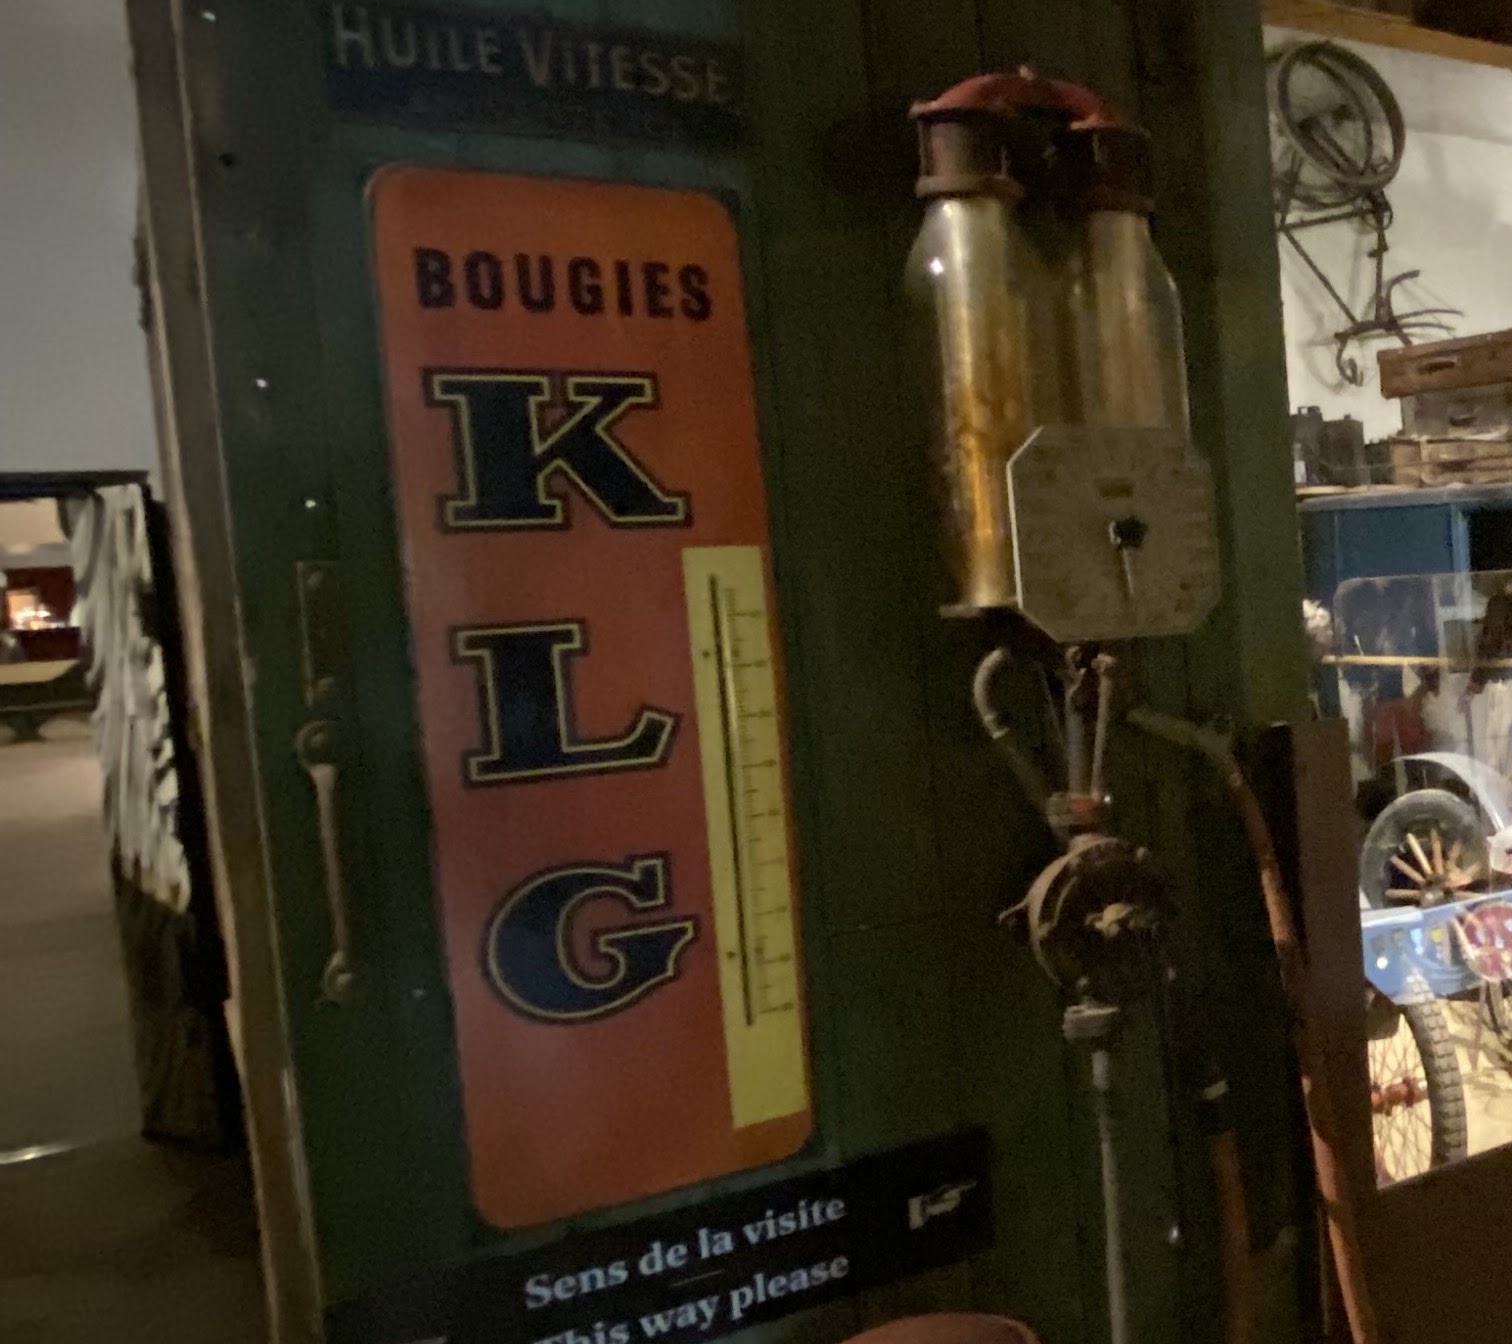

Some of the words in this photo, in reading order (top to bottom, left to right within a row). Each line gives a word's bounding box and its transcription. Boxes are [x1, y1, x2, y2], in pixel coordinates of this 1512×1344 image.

[332, 2, 503, 73] HUILE
[412, 247, 714, 322] BOUGIES
[422, 366, 692, 533] K
[449, 616, 680, 789] L
[481, 849, 700, 1025] G
[523, 1258, 630, 1310] Sens
[637, 1240, 689, 1278] de
[698, 1225, 737, 1259] la
[741, 1195, 848, 1247] visite
[639, 1293, 722, 1342] way
[728, 1255, 852, 1321] please
